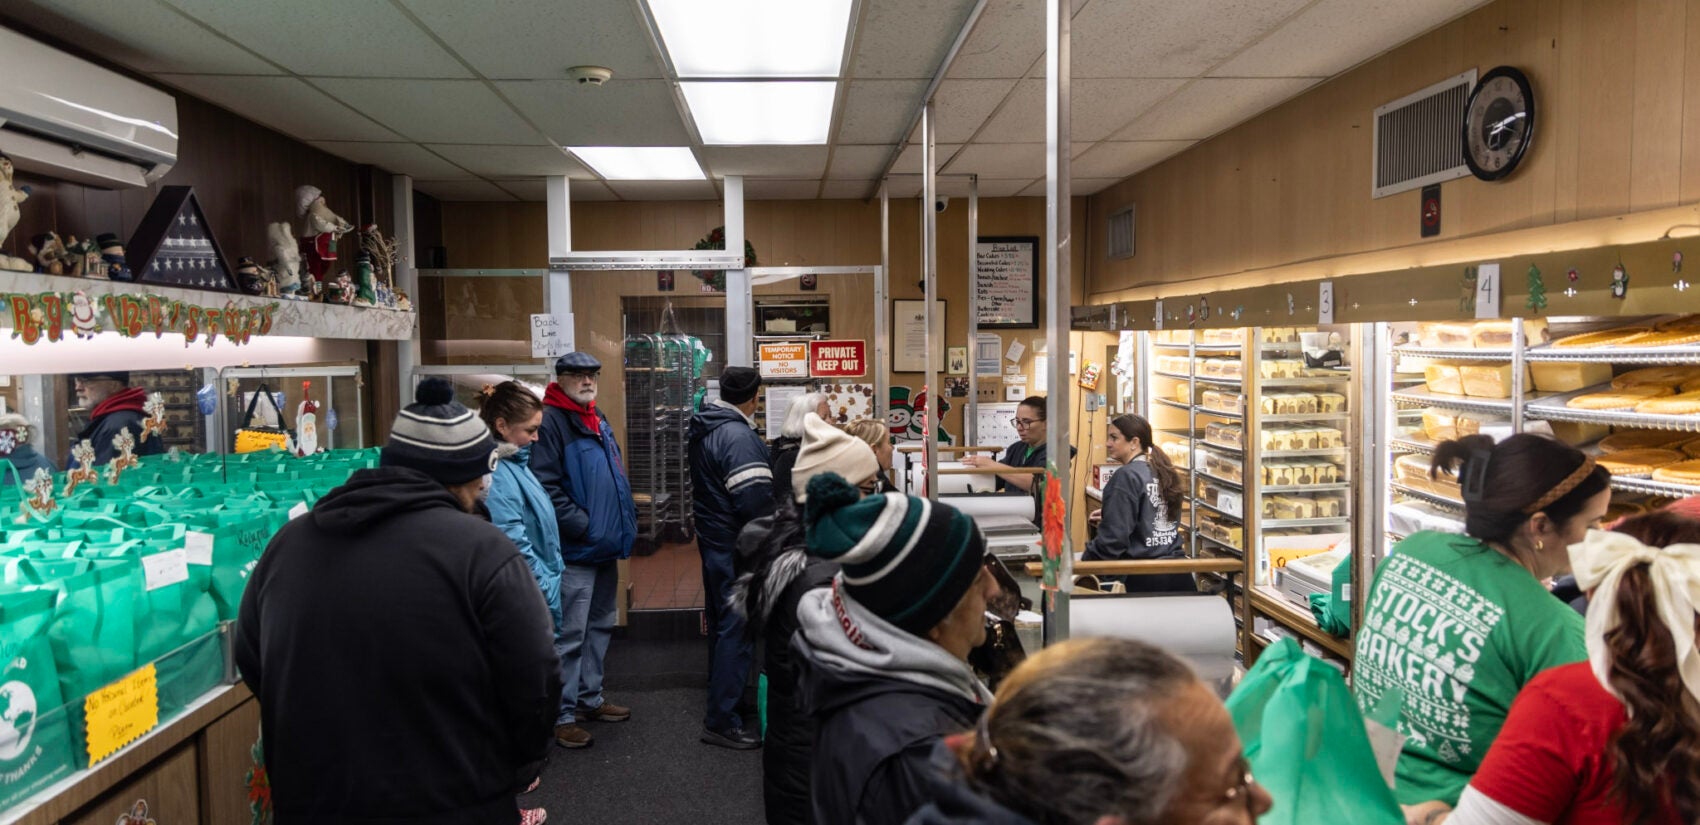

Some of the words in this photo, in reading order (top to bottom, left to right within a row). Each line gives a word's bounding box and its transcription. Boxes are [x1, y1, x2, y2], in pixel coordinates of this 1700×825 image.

[1481, 274, 1492, 304] 4
[1321, 290, 1330, 314] 3
[533, 315, 560, 328] Back
[542, 328, 557, 337] Line
[818, 346, 857, 358] PRIVATE
[816, 360, 839, 371] KEEP
[842, 360, 859, 371] OUT
[1372, 581, 1485, 663] STOCK'S
[1358, 625, 1468, 704] BAKERY
[88, 697, 100, 711] No
